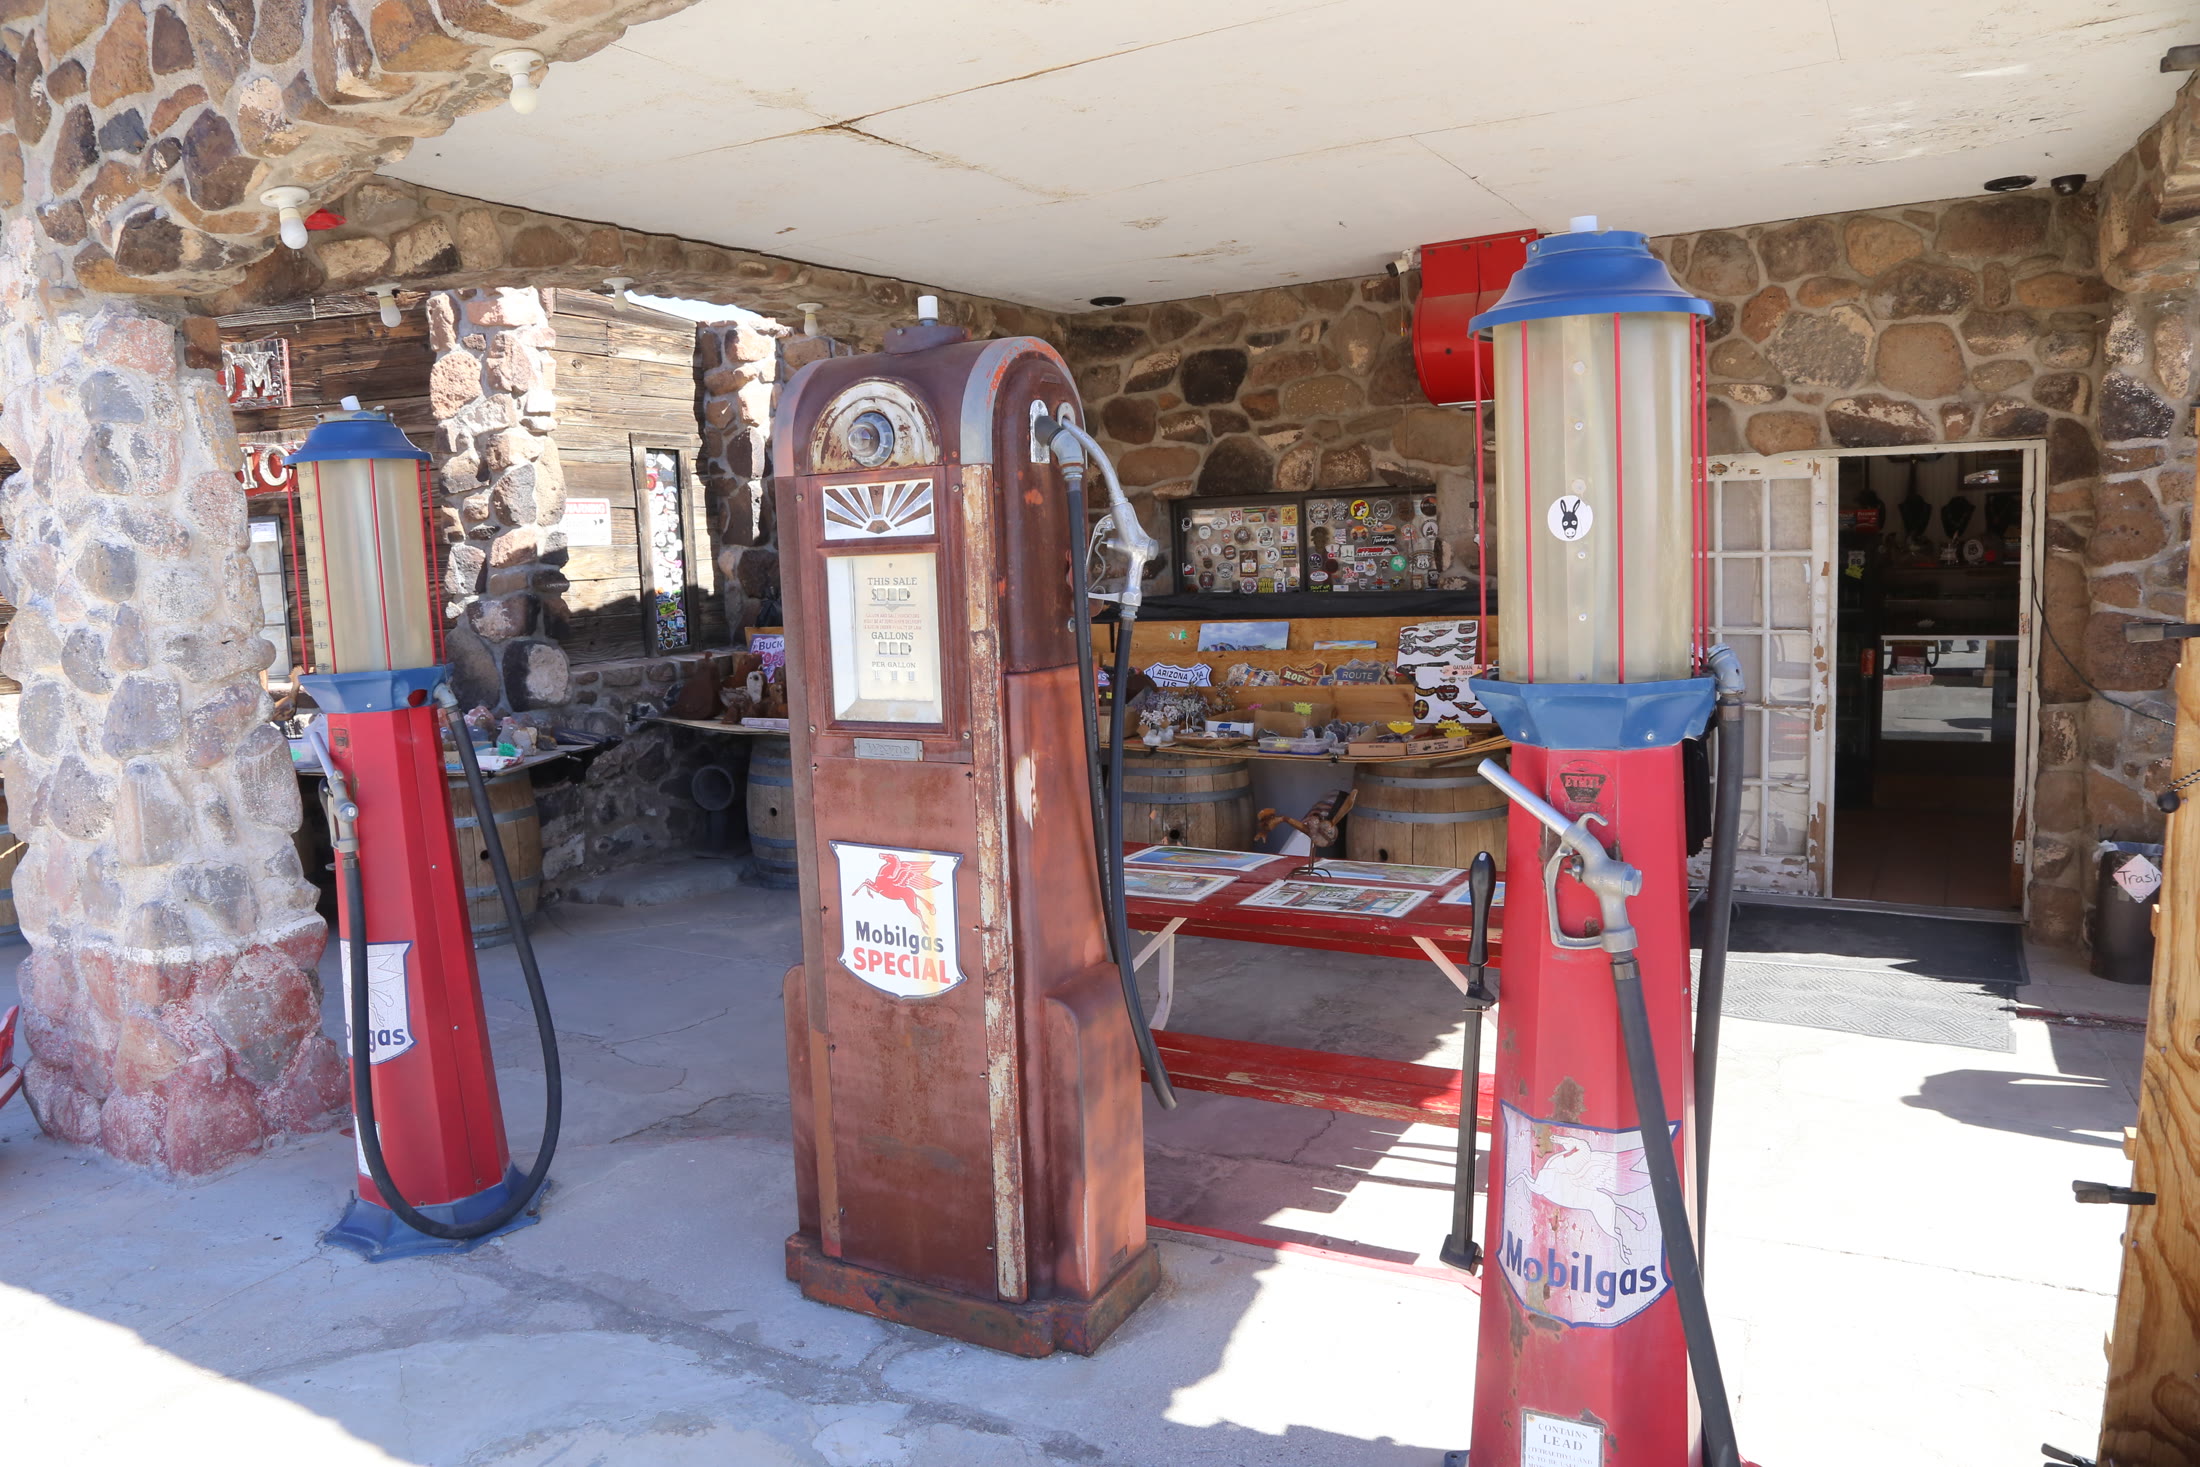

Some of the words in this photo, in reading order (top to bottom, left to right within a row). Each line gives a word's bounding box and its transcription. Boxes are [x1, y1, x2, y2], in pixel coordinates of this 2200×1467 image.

[867, 577, 890, 586] THIS
[893, 577, 918, 586] SALE
[871, 632, 914, 640] GALLONS
[758, 640, 783, 650] BUCK
[1156, 669, 1188, 680] ARIZONA
[1342, 671, 1374, 680] ROUTE
[1565, 776, 1602, 788] ETHYL
[2116, 868, 2162, 885] Trash
[855, 920, 944, 955] Mobilgas
[852, 946, 951, 984] SPECIAL
[1506, 1229, 1658, 1309] Mobilgas
[1538, 1423, 1588, 1439] CONTAINS
[1543, 1434, 1583, 1451] LEAD
